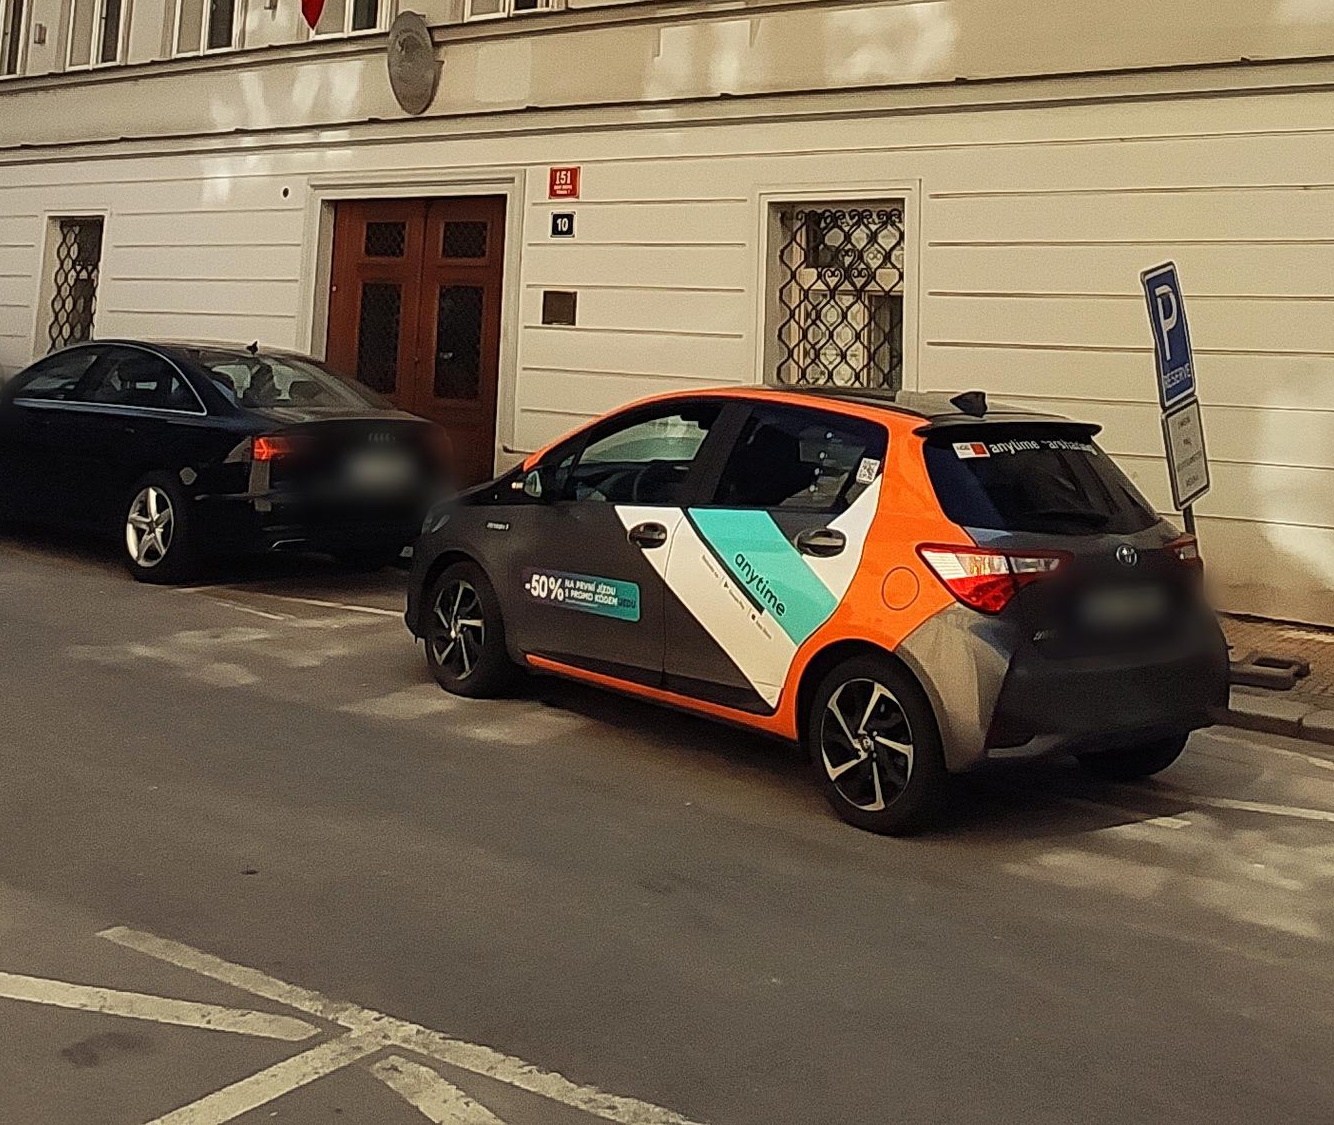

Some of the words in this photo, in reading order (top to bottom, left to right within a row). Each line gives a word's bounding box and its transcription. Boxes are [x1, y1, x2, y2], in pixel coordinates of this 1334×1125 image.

[555, 170, 571, 185] 151
[556, 218, 569, 232] 10
[1154, 284, 1178, 362] P
[989, 439, 1040, 455] anytime
[524, 573, 564, 602] -50%
[734, 553, 786, 617] anytime
